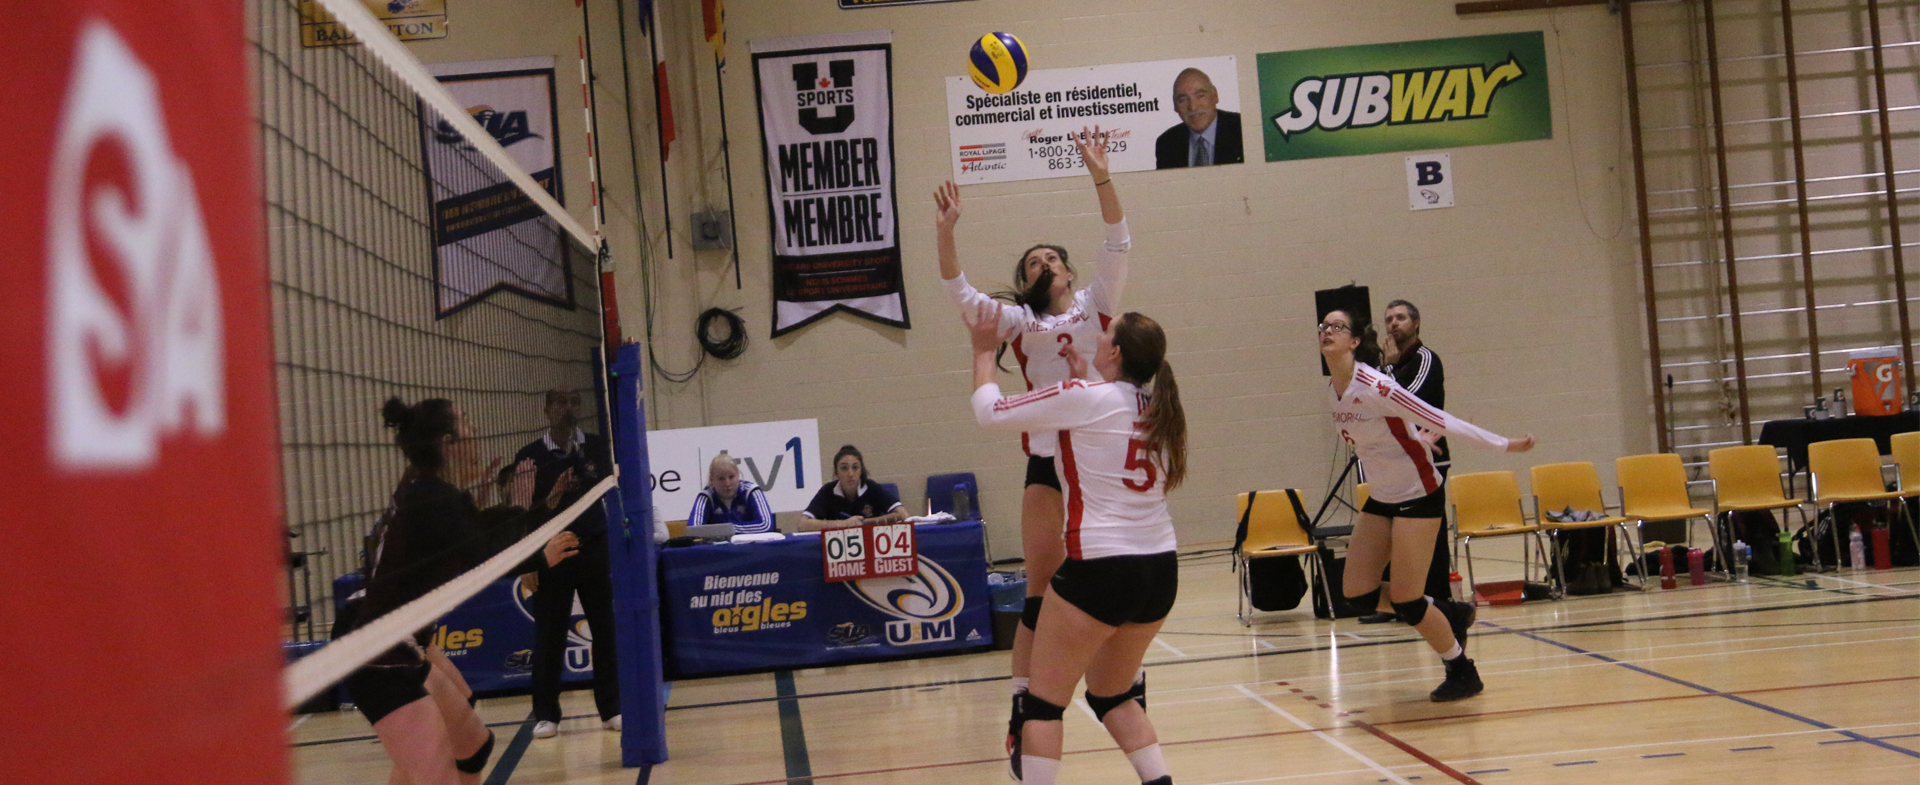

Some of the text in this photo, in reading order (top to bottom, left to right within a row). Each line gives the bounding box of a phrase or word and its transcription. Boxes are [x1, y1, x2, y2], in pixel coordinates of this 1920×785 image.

[797, 89, 855, 107] SPORTS
[966, 82, 1142, 111] Spécialiste en résidentiel,
[1275, 57, 1523, 135] SUBWAY
[955, 97, 1160, 127] commercial et investissement
[1030, 134, 1064, 145] Roger
[778, 137, 881, 192] MEMBER
[962, 161, 1007, 173] Atlantic
[1415, 161, 1444, 187] B
[784, 193, 884, 248] MEMBRE
[1876, 363, 1893, 382] G
[1122, 434, 1159, 493] 5
[828, 531, 910, 559] 05 04
[703, 571, 779, 590] Bienvenue
[829, 558, 913, 578] HOME GUEST
[690, 589, 762, 608] au nid des
[711, 596, 807, 632] aigles
[714, 621, 792, 634] bleus bleues
